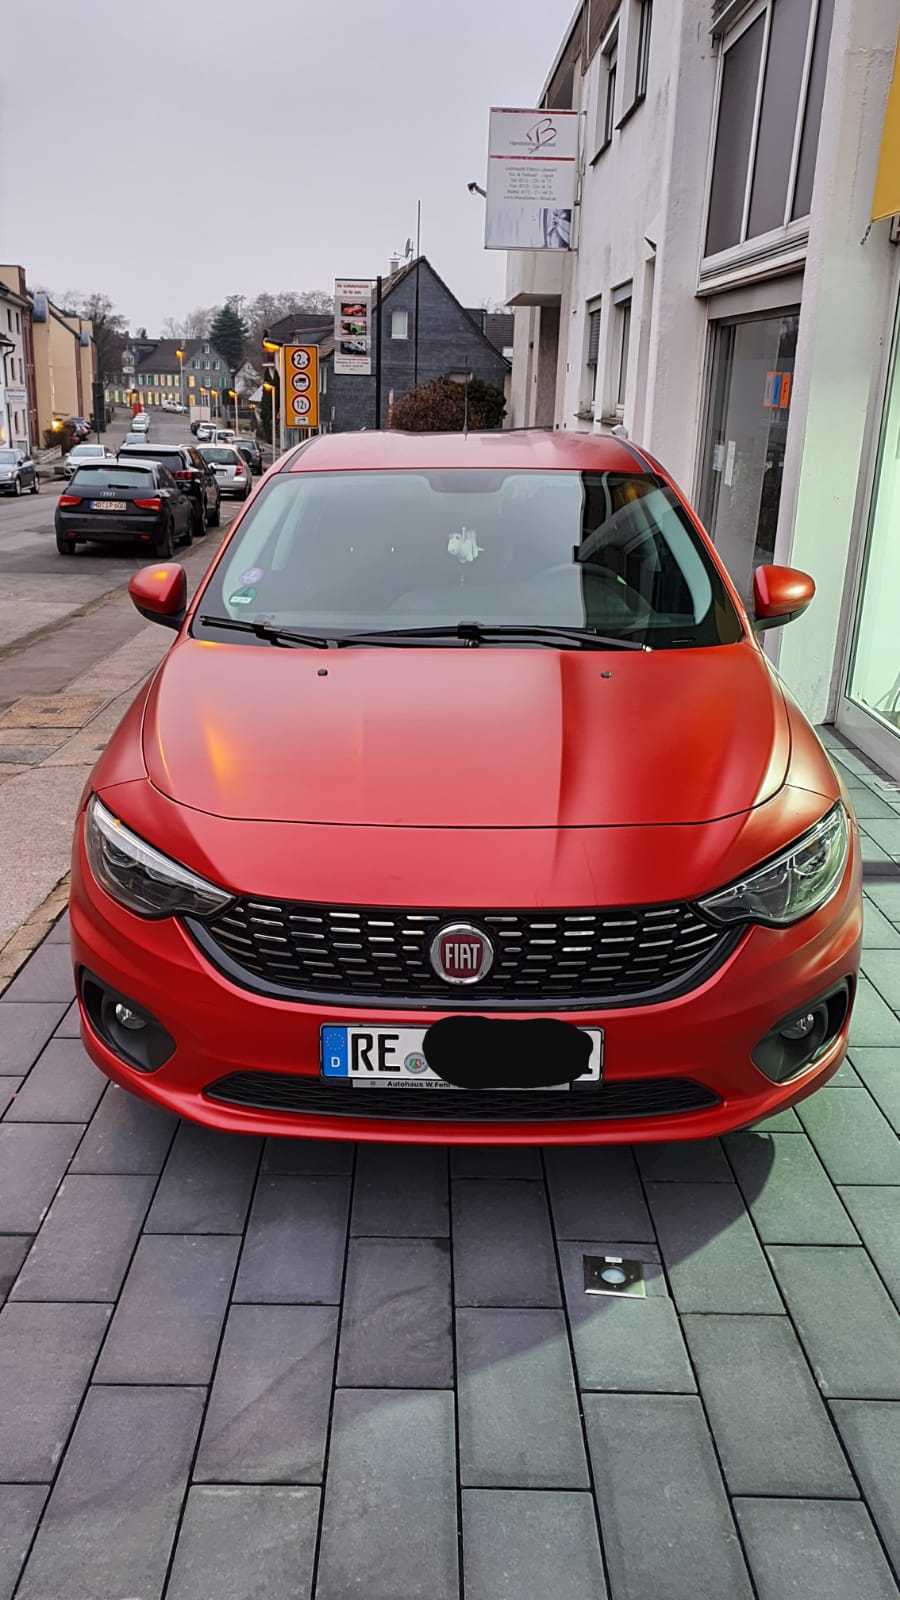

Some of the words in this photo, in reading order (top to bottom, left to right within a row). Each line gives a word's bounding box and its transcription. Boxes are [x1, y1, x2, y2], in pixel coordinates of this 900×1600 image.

[445, 943, 481, 969] FIAT
[331, 1056, 340, 1068] D
[351, 1033, 401, 1072] RE
[387, 1080, 424, 1088] Autohaus
